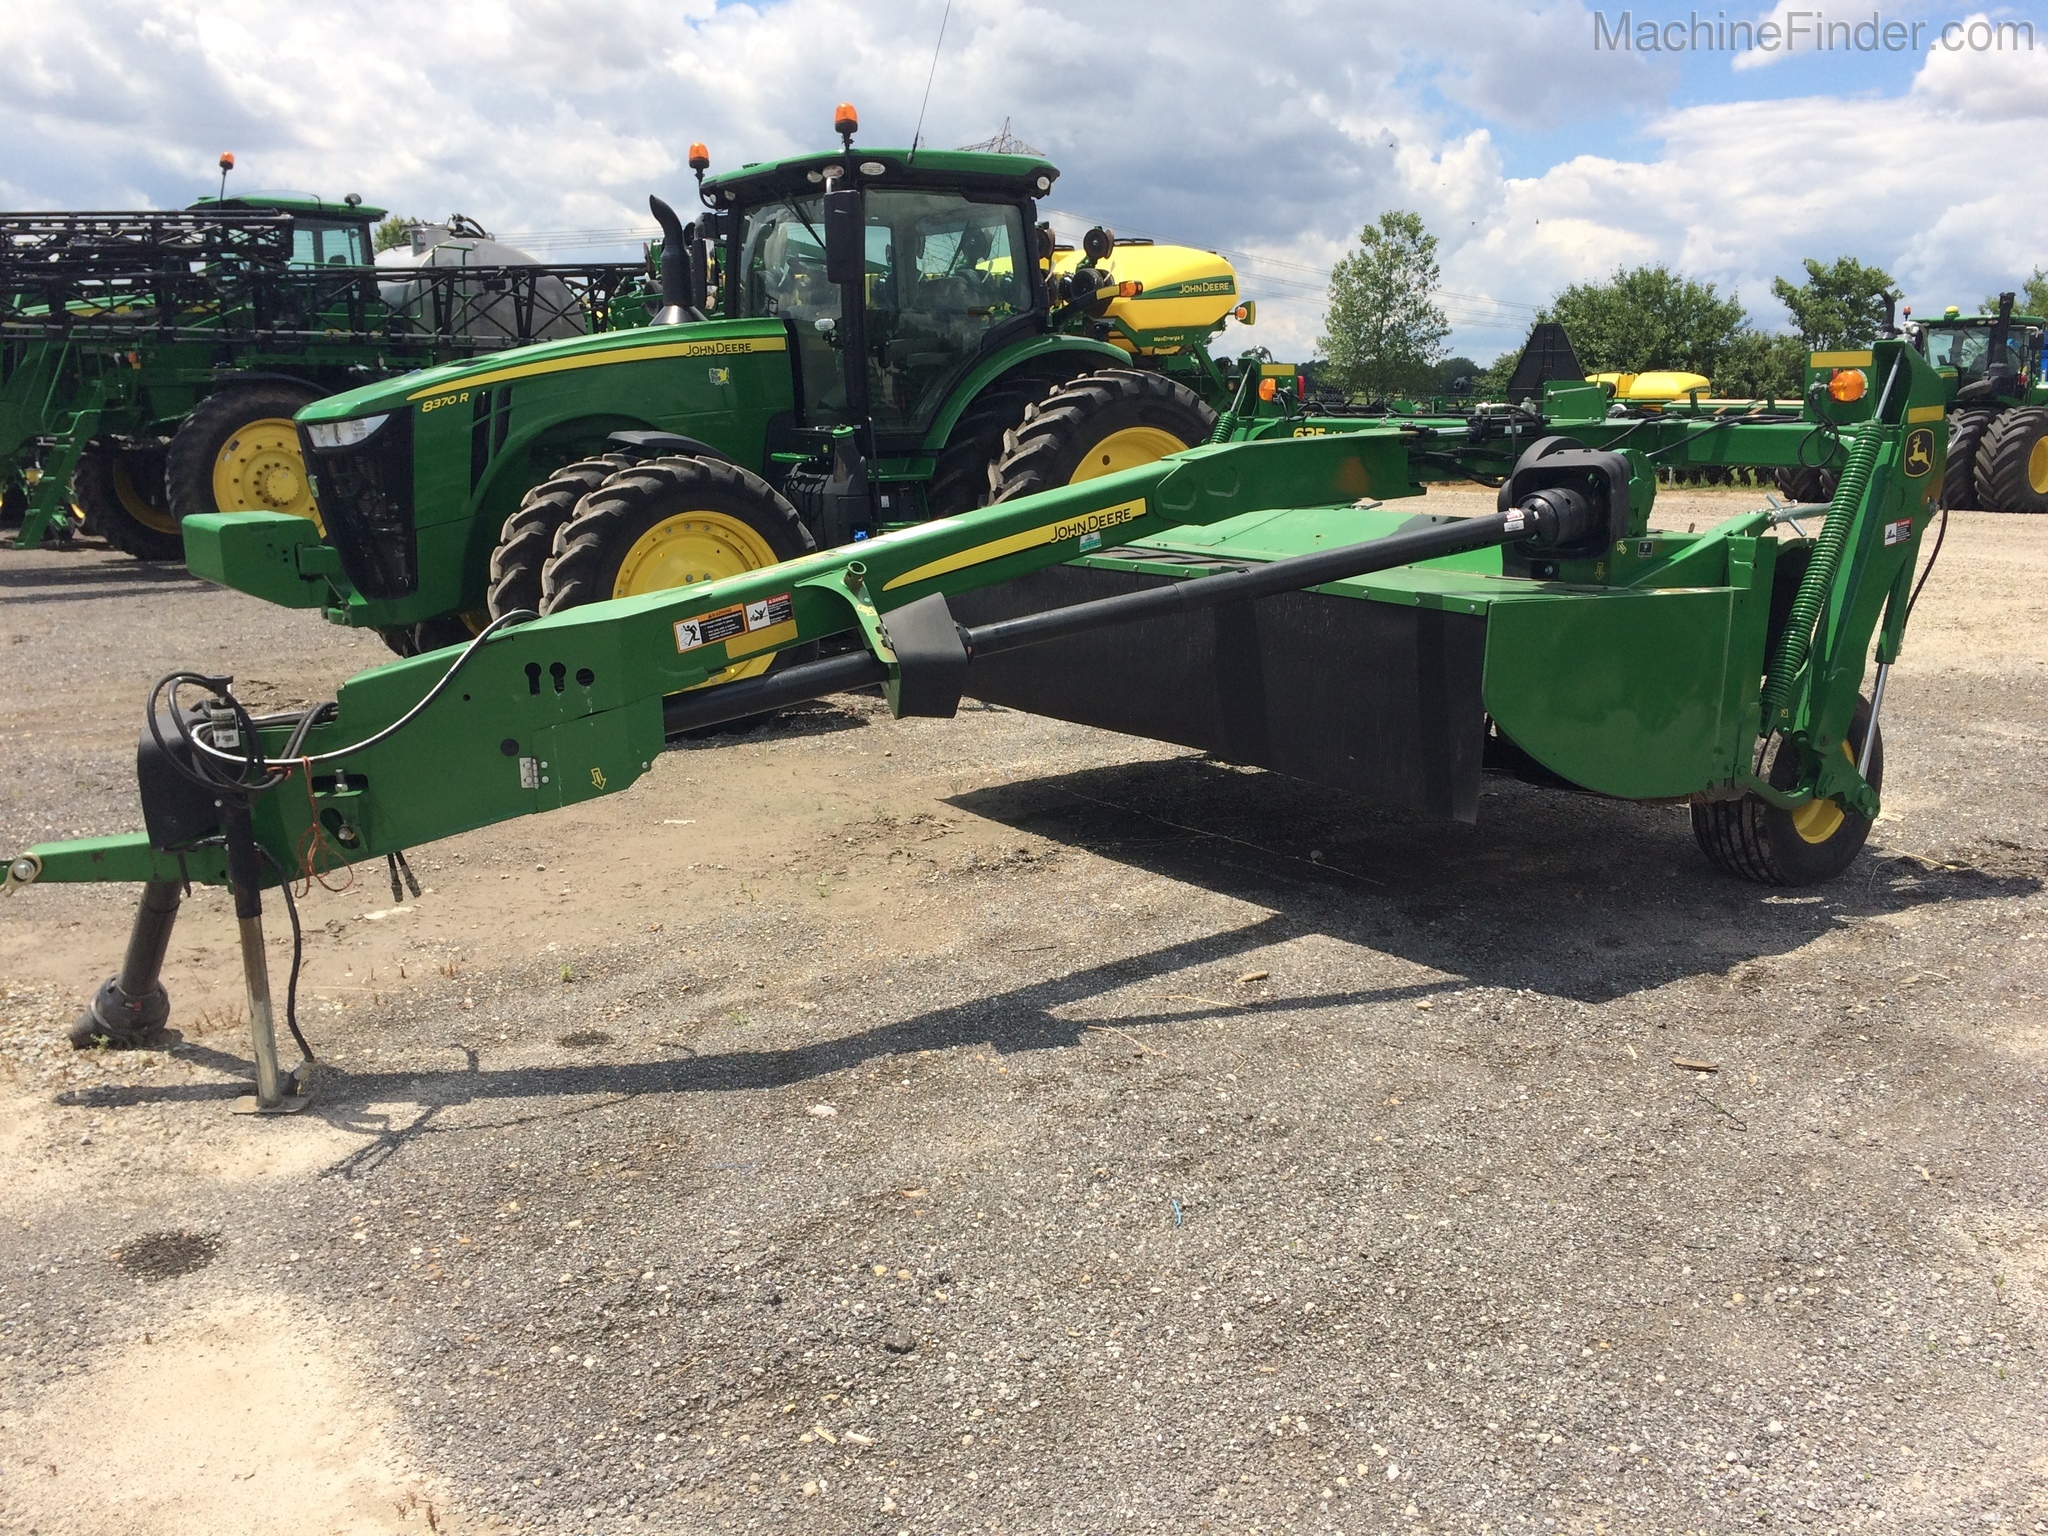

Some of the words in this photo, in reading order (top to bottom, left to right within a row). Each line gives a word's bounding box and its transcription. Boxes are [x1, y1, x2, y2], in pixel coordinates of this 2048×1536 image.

[1179, 284, 1203, 294] JOHN
[1203, 282, 1230, 292] DEERE
[685, 344, 715, 356] JOHN
[716, 342, 752, 354] DEERE
[421, 395, 457, 413] 8370
[459, 392, 470, 403] R
[1051, 520, 1087, 542] JOHN
[1088, 508, 1132, 530] DEERE
